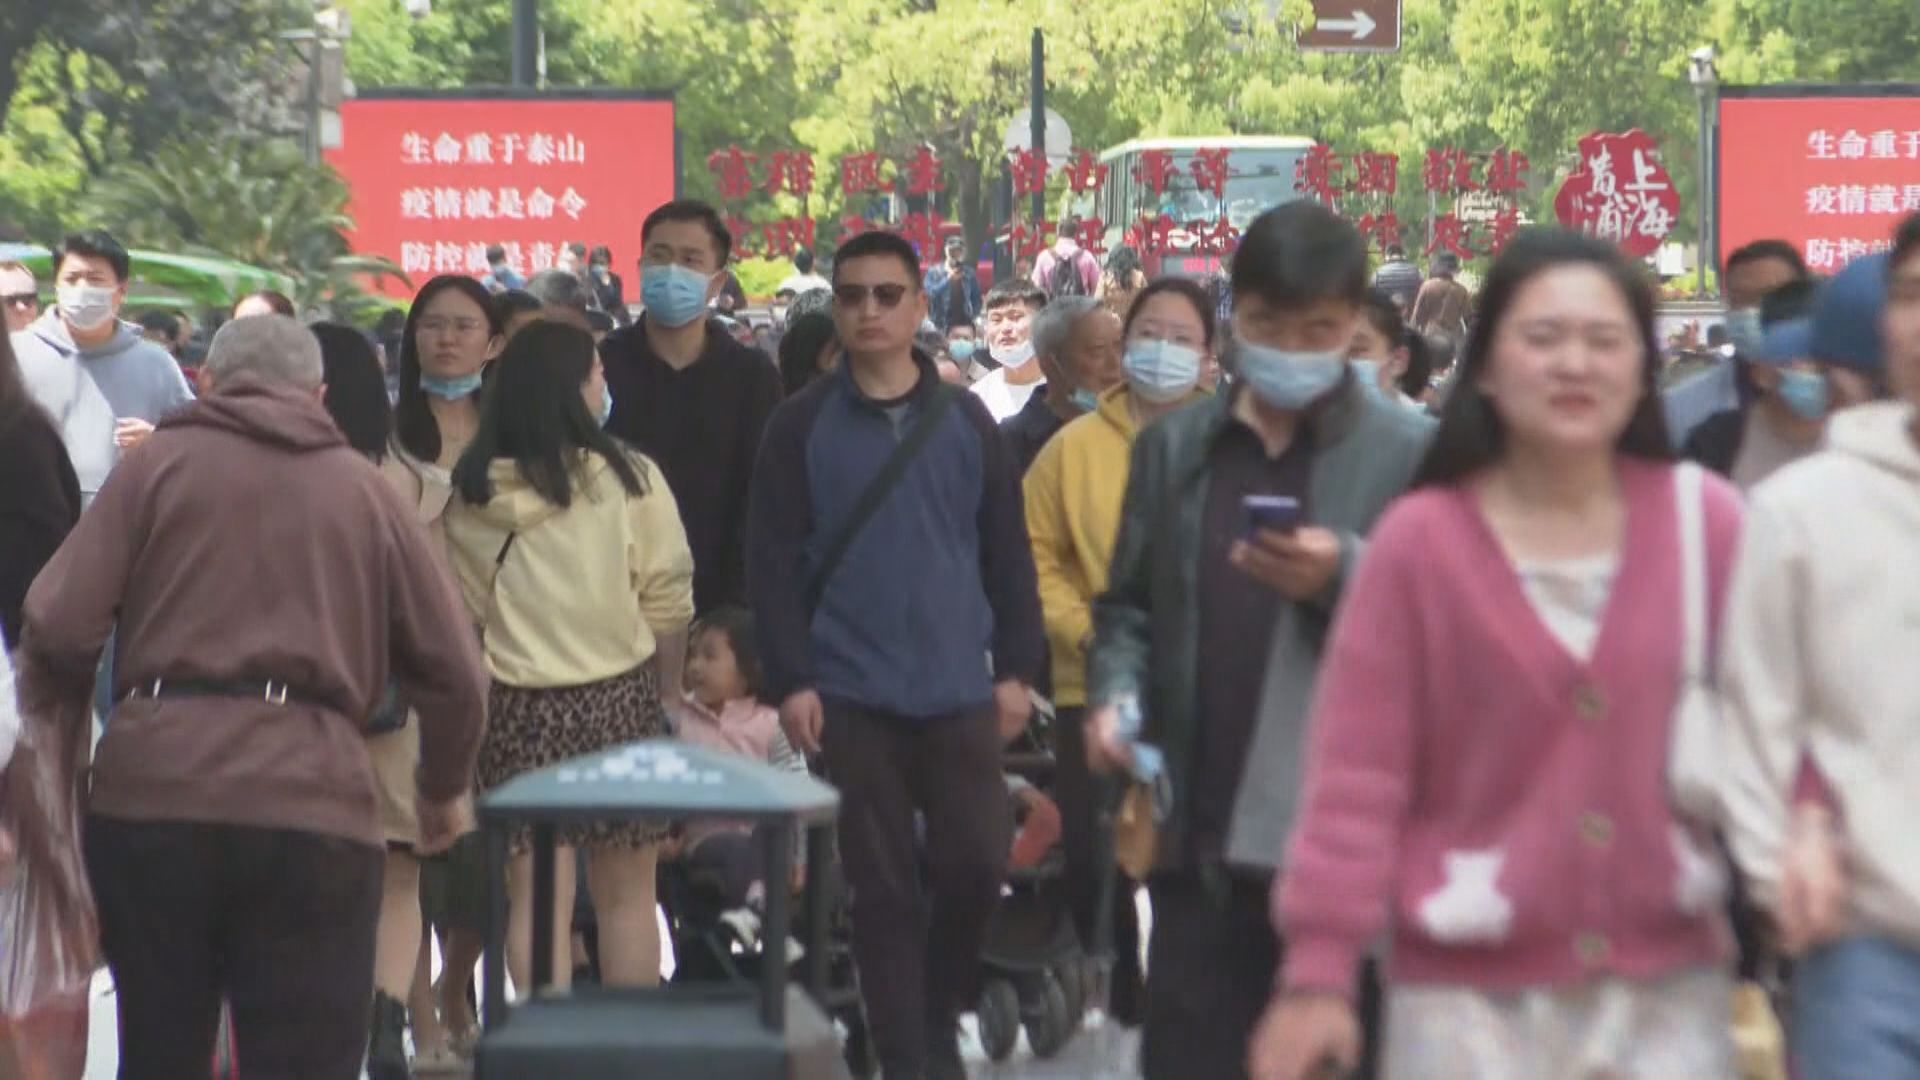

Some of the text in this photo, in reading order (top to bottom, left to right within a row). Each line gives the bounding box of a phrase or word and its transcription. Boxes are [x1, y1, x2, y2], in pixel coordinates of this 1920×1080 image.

[401, 131, 585, 165] 生命重于泰山
[400, 186, 587, 220] 疫情就是命令
[1624, 147, 1675, 238] 上海
